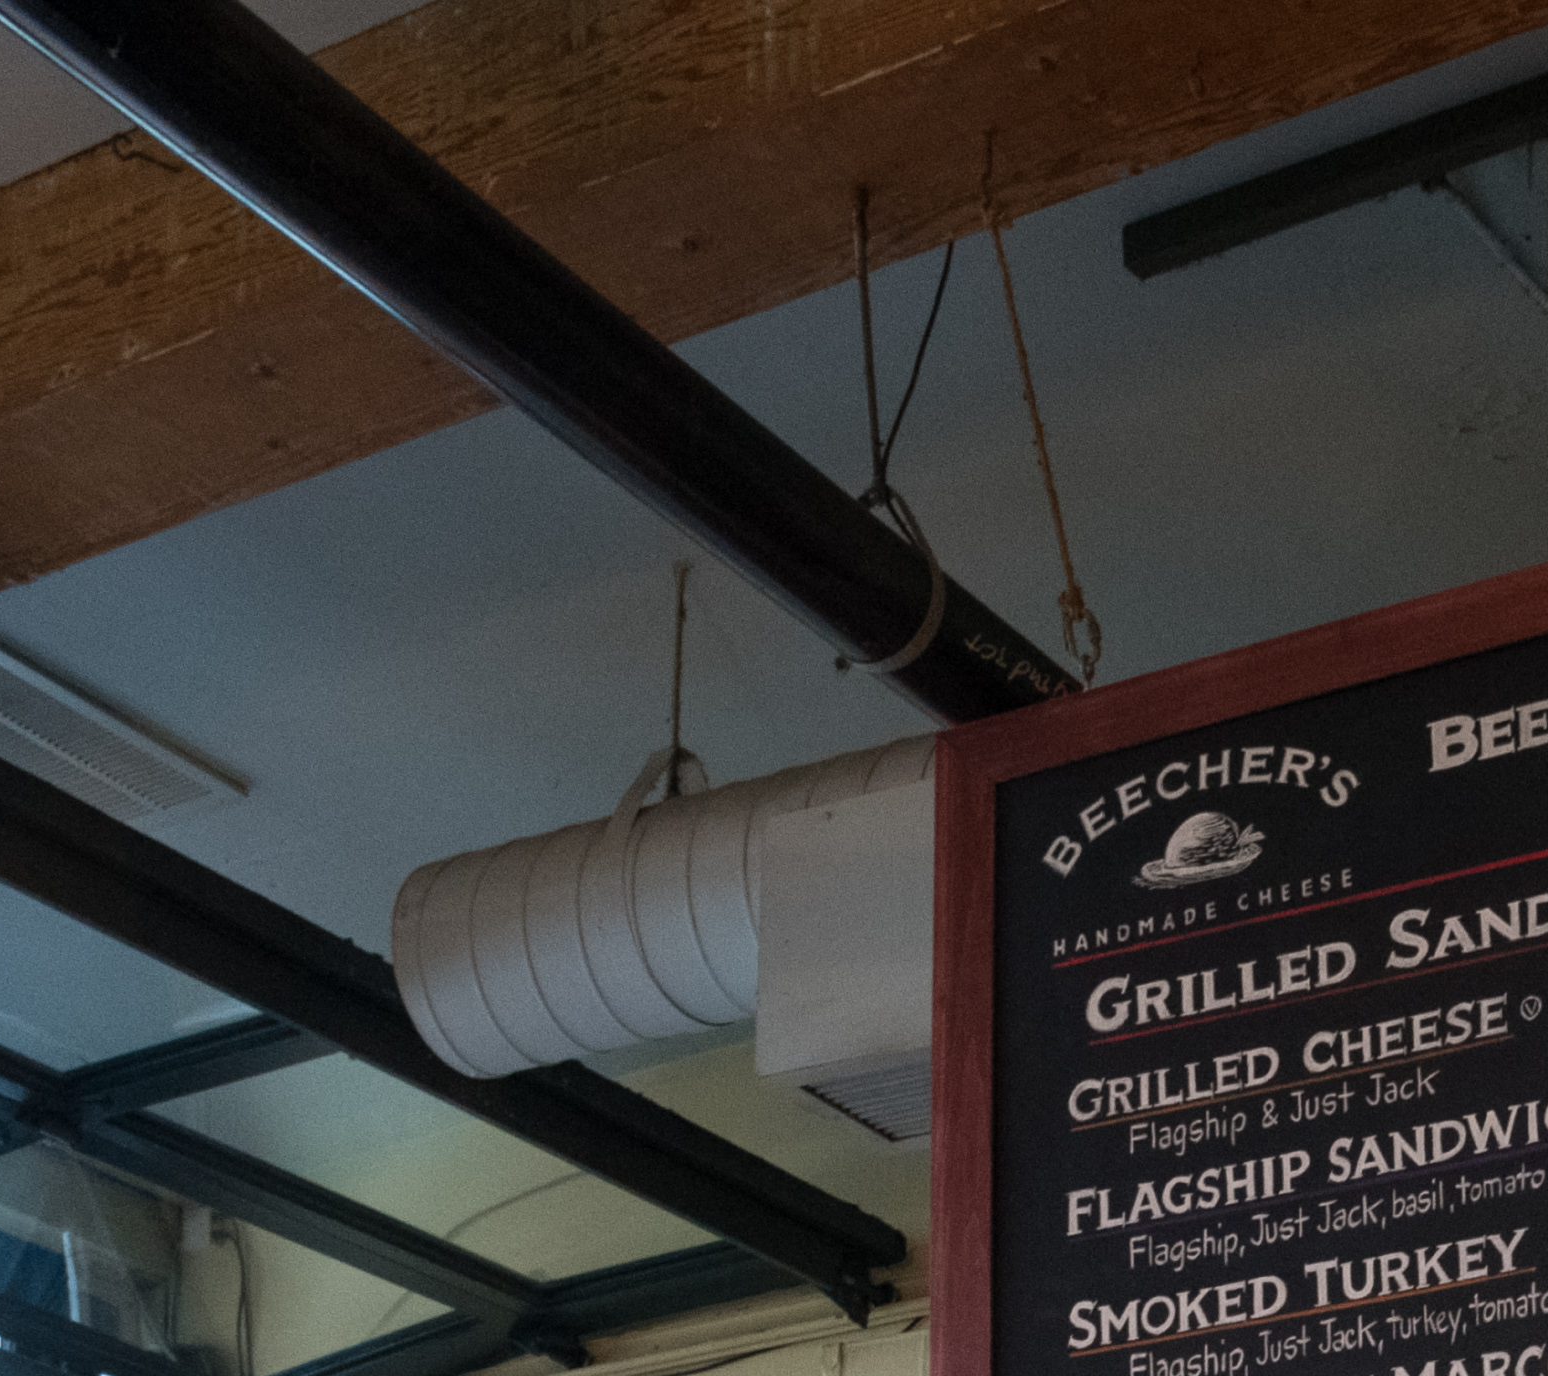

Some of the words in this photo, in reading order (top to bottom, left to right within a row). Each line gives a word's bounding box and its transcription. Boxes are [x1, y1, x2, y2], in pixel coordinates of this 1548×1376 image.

[1043, 746, 1360, 877] BEECHER'S
[1054, 903, 1218, 957] HANDMADE
[1237, 869, 1354, 911] CHEESE
[1086, 940, 1357, 1033] GRILLED
[1068, 1045, 1280, 1123] GRILLED
[1302, 992, 1510, 1076] CHEESE
[1129, 1100, 1246, 1157] Flagship
[1263, 1102, 1279, 1126] &
[1290, 1086, 1354, 1123] Just
[1365, 1067, 1439, 1106] Jack
[1064, 1148, 1313, 1235] FLAGSHIP
[1067, 1274, 1288, 1351] SMOKED
[1304, 1227, 1529, 1309] TURKEY
[1257, 1326, 1310, 1365] Just
[1318, 1317, 1384, 1355] Jack,
[1388, 1297, 1468, 1349] turkey,
